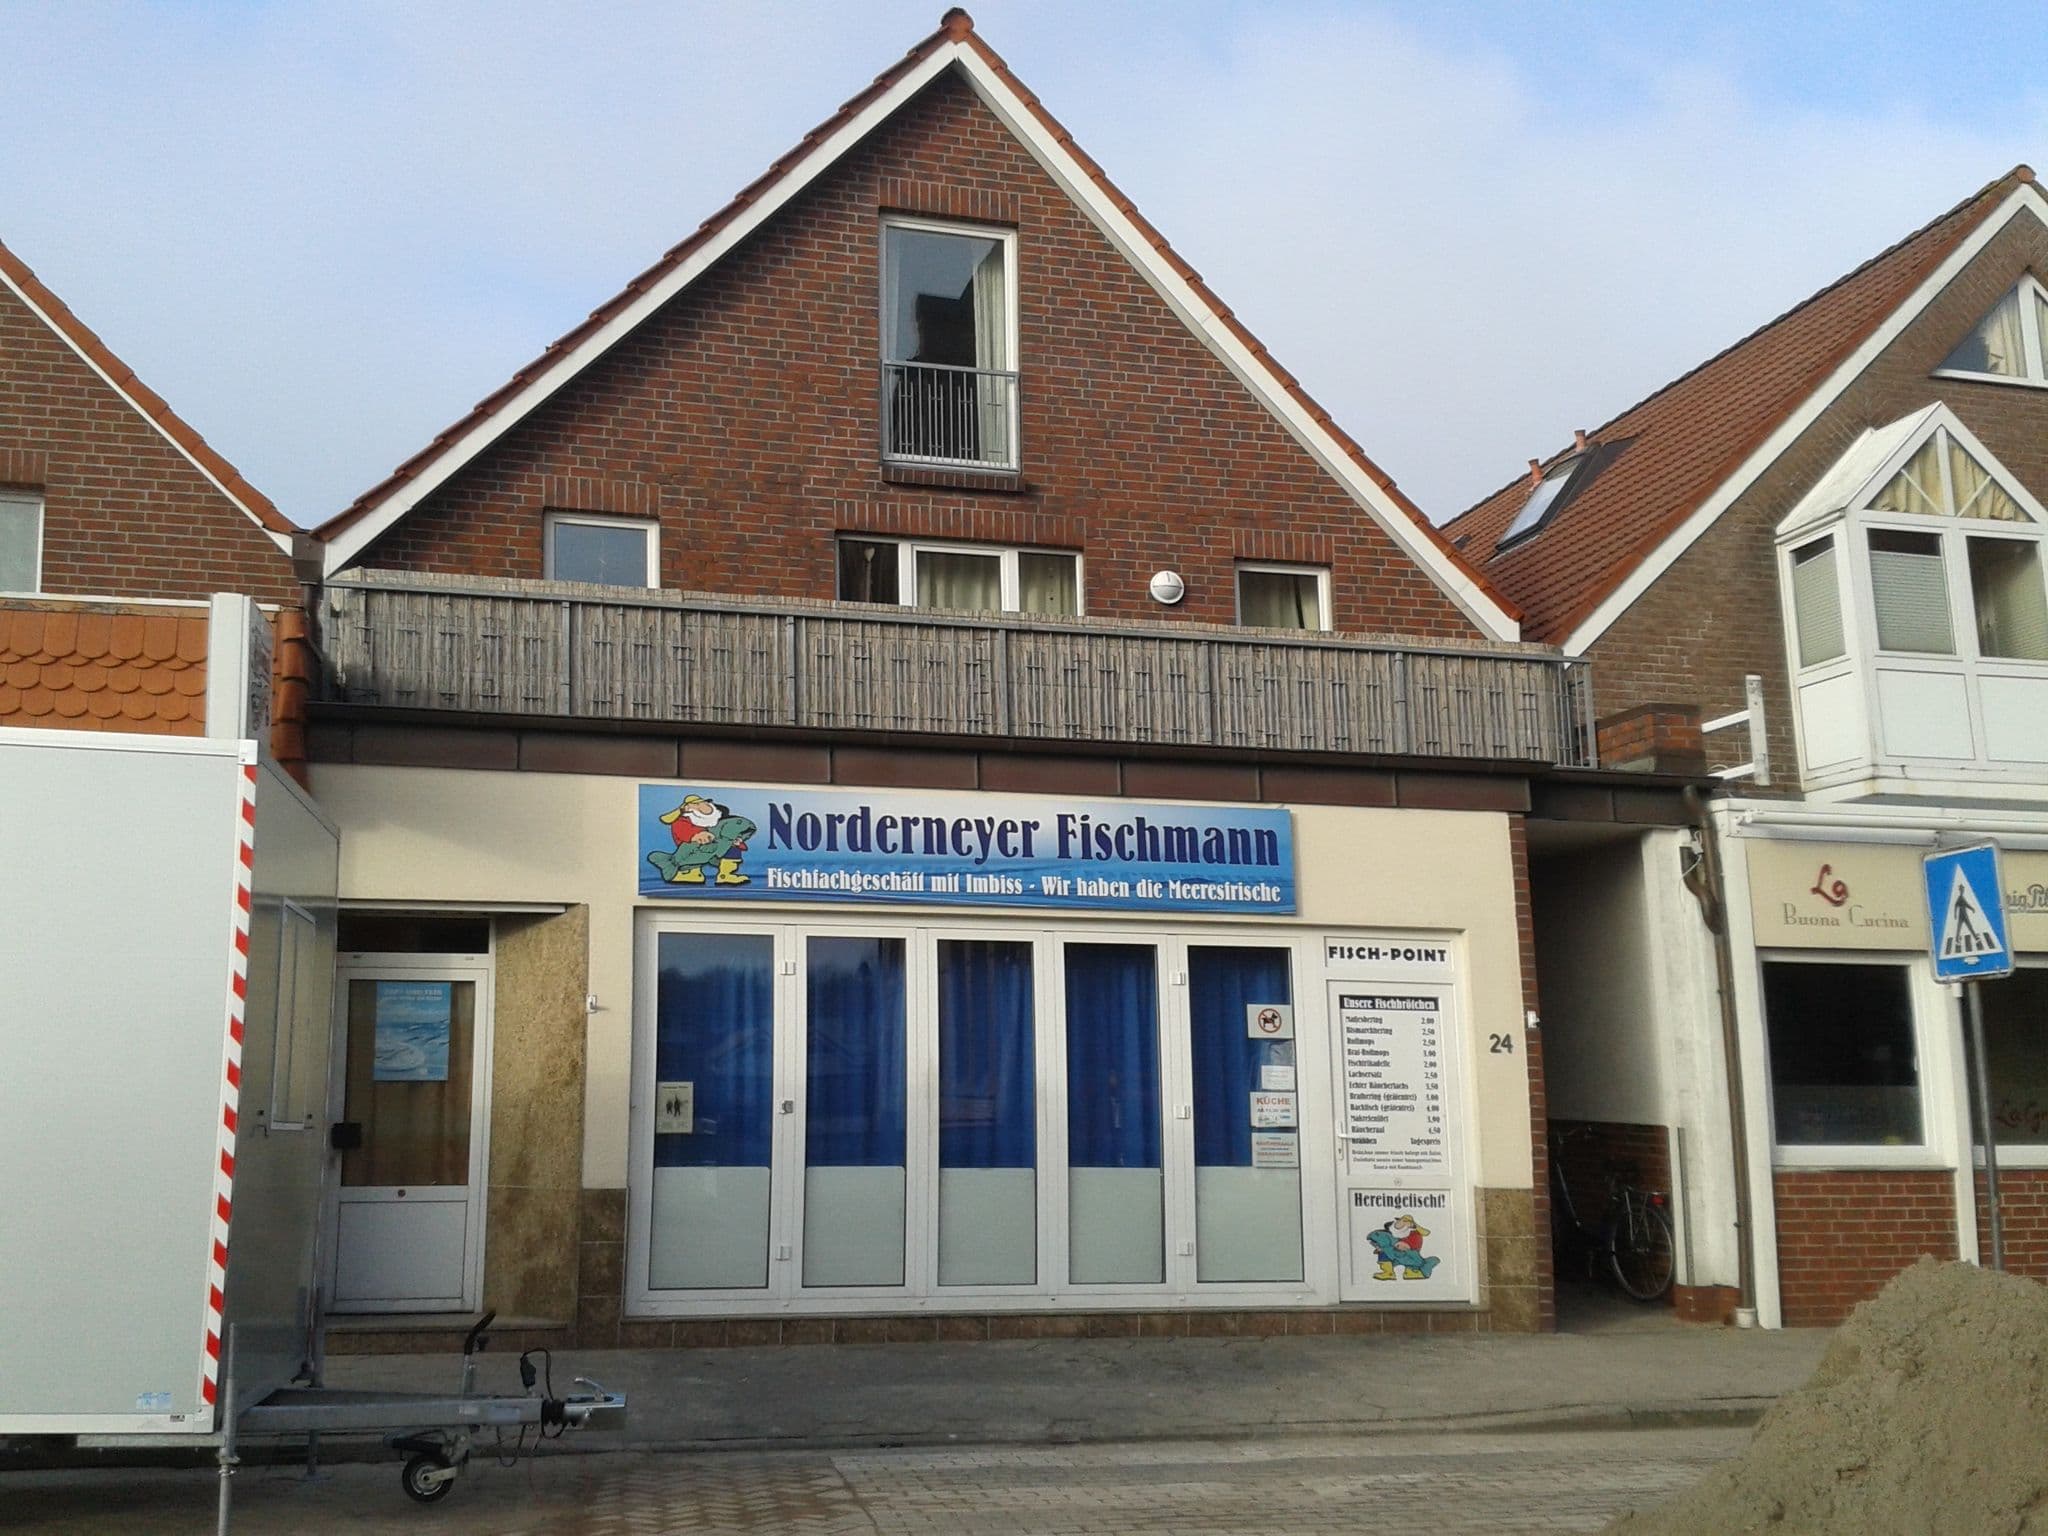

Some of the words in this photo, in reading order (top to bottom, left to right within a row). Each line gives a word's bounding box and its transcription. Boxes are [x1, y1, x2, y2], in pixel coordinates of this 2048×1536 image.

[768, 803, 1040, 865] Norderneyer
[1056, 813, 1279, 866] Fischmann
[767, 867, 924, 894] Fischfachgeschäft
[931, 873, 959, 893] mit
[966, 874, 1023, 895] Imbiss
[1041, 876, 1071, 897] Wir
[1076, 877, 1130, 898] haben
[1136, 879, 1163, 899] die
[1169, 880, 1281, 903] Meeresfrische
[1783, 903, 1840, 926] Buona
[1328, 946, 1447, 962] FISCH-POINT
[1343, 997, 1374, 1009] Unsere
[1489, 1033, 1514, 1054] 24
[1256, 1096, 1291, 1105] KÜCHE
[1354, 1192, 1446, 1209] Hereingefischt!
